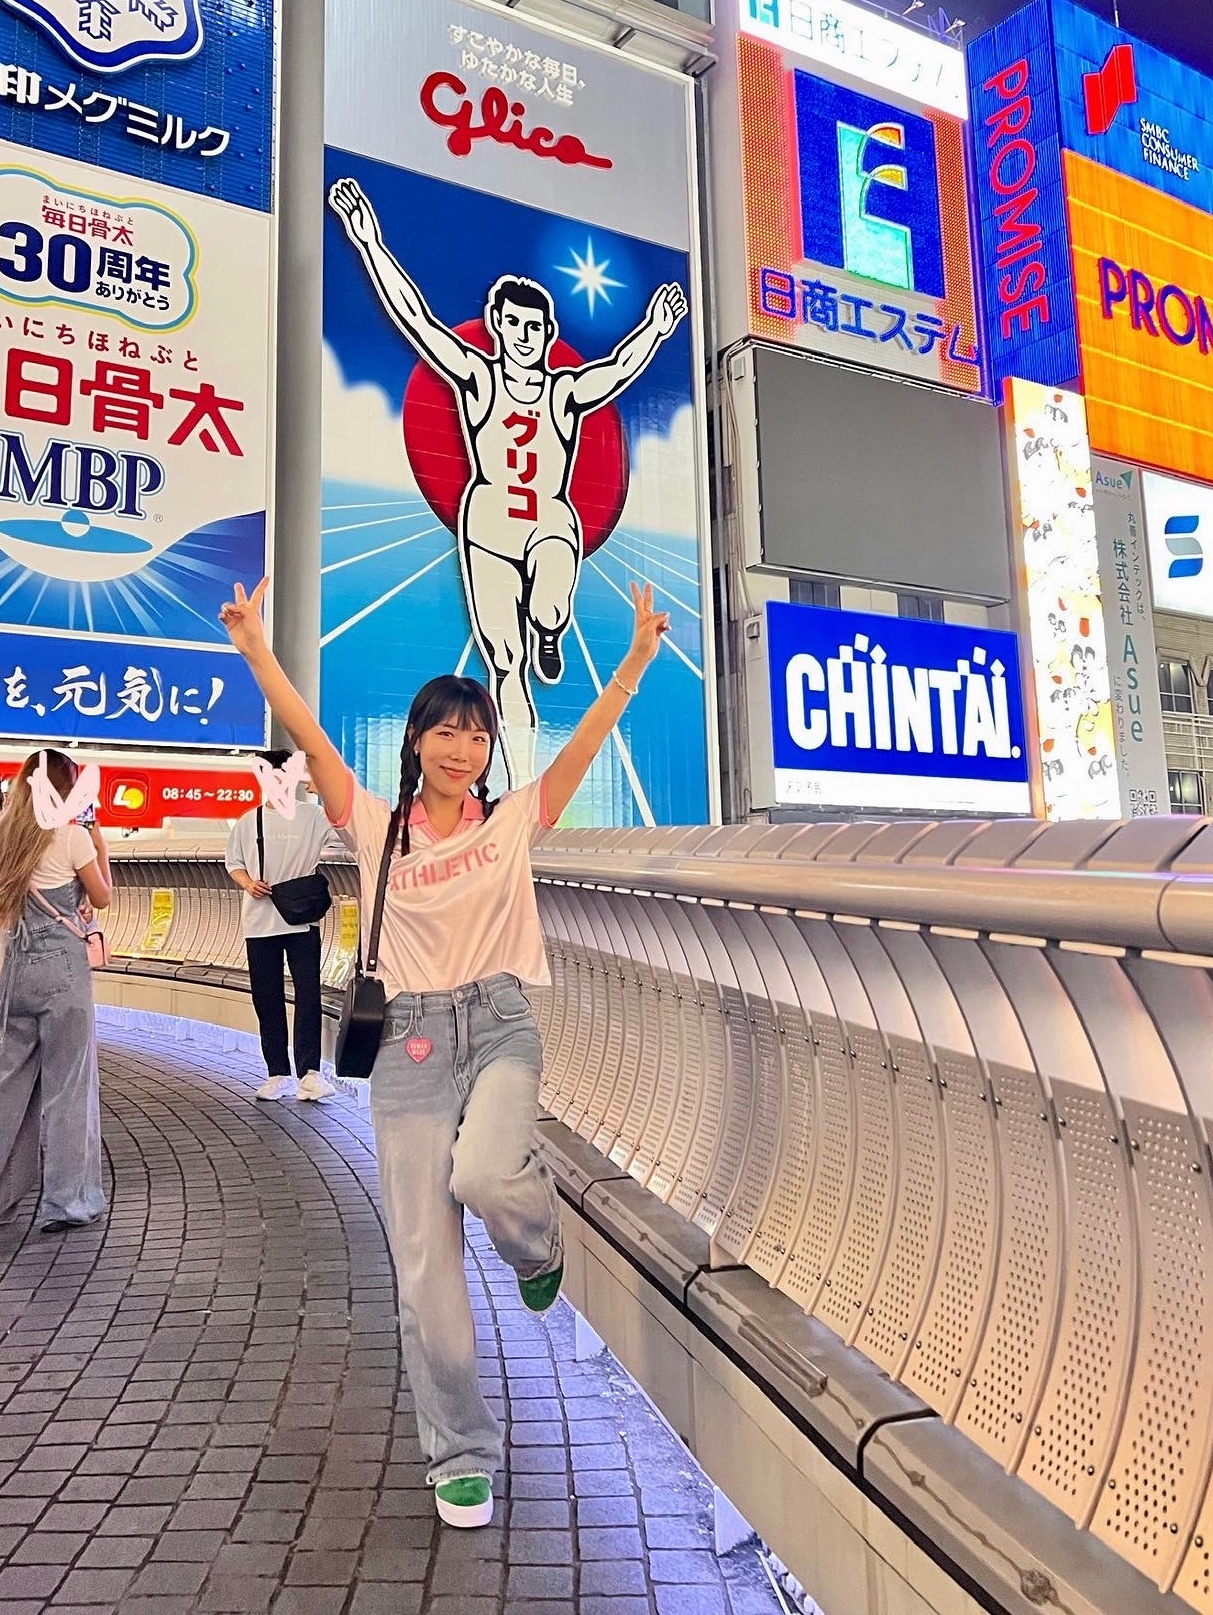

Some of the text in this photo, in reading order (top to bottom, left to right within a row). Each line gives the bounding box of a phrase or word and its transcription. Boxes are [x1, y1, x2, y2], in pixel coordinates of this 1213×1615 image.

[460, 49, 574, 106] ゆたかな人生
[0, 62, 230, 157] 印メグミルク
[420, 71, 613, 169] Glico
[1140, 118, 1170, 143] SMBC
[1141, 133, 1199, 172] CONSUMER
[1143, 148, 1190, 180] FINANCE
[42, 195, 134, 226] まいにちほねぶと
[983, 58, 1049, 339] PROMISE
[41, 205, 134, 247] 毎日骨太
[95, 281, 170, 311] ありがとう
[4, 347, 244, 457] 日骨太
[0, 430, 165, 520] MBP
[502, 409, 541, 522] グリコ
[1095, 470, 1123, 489] Asue
